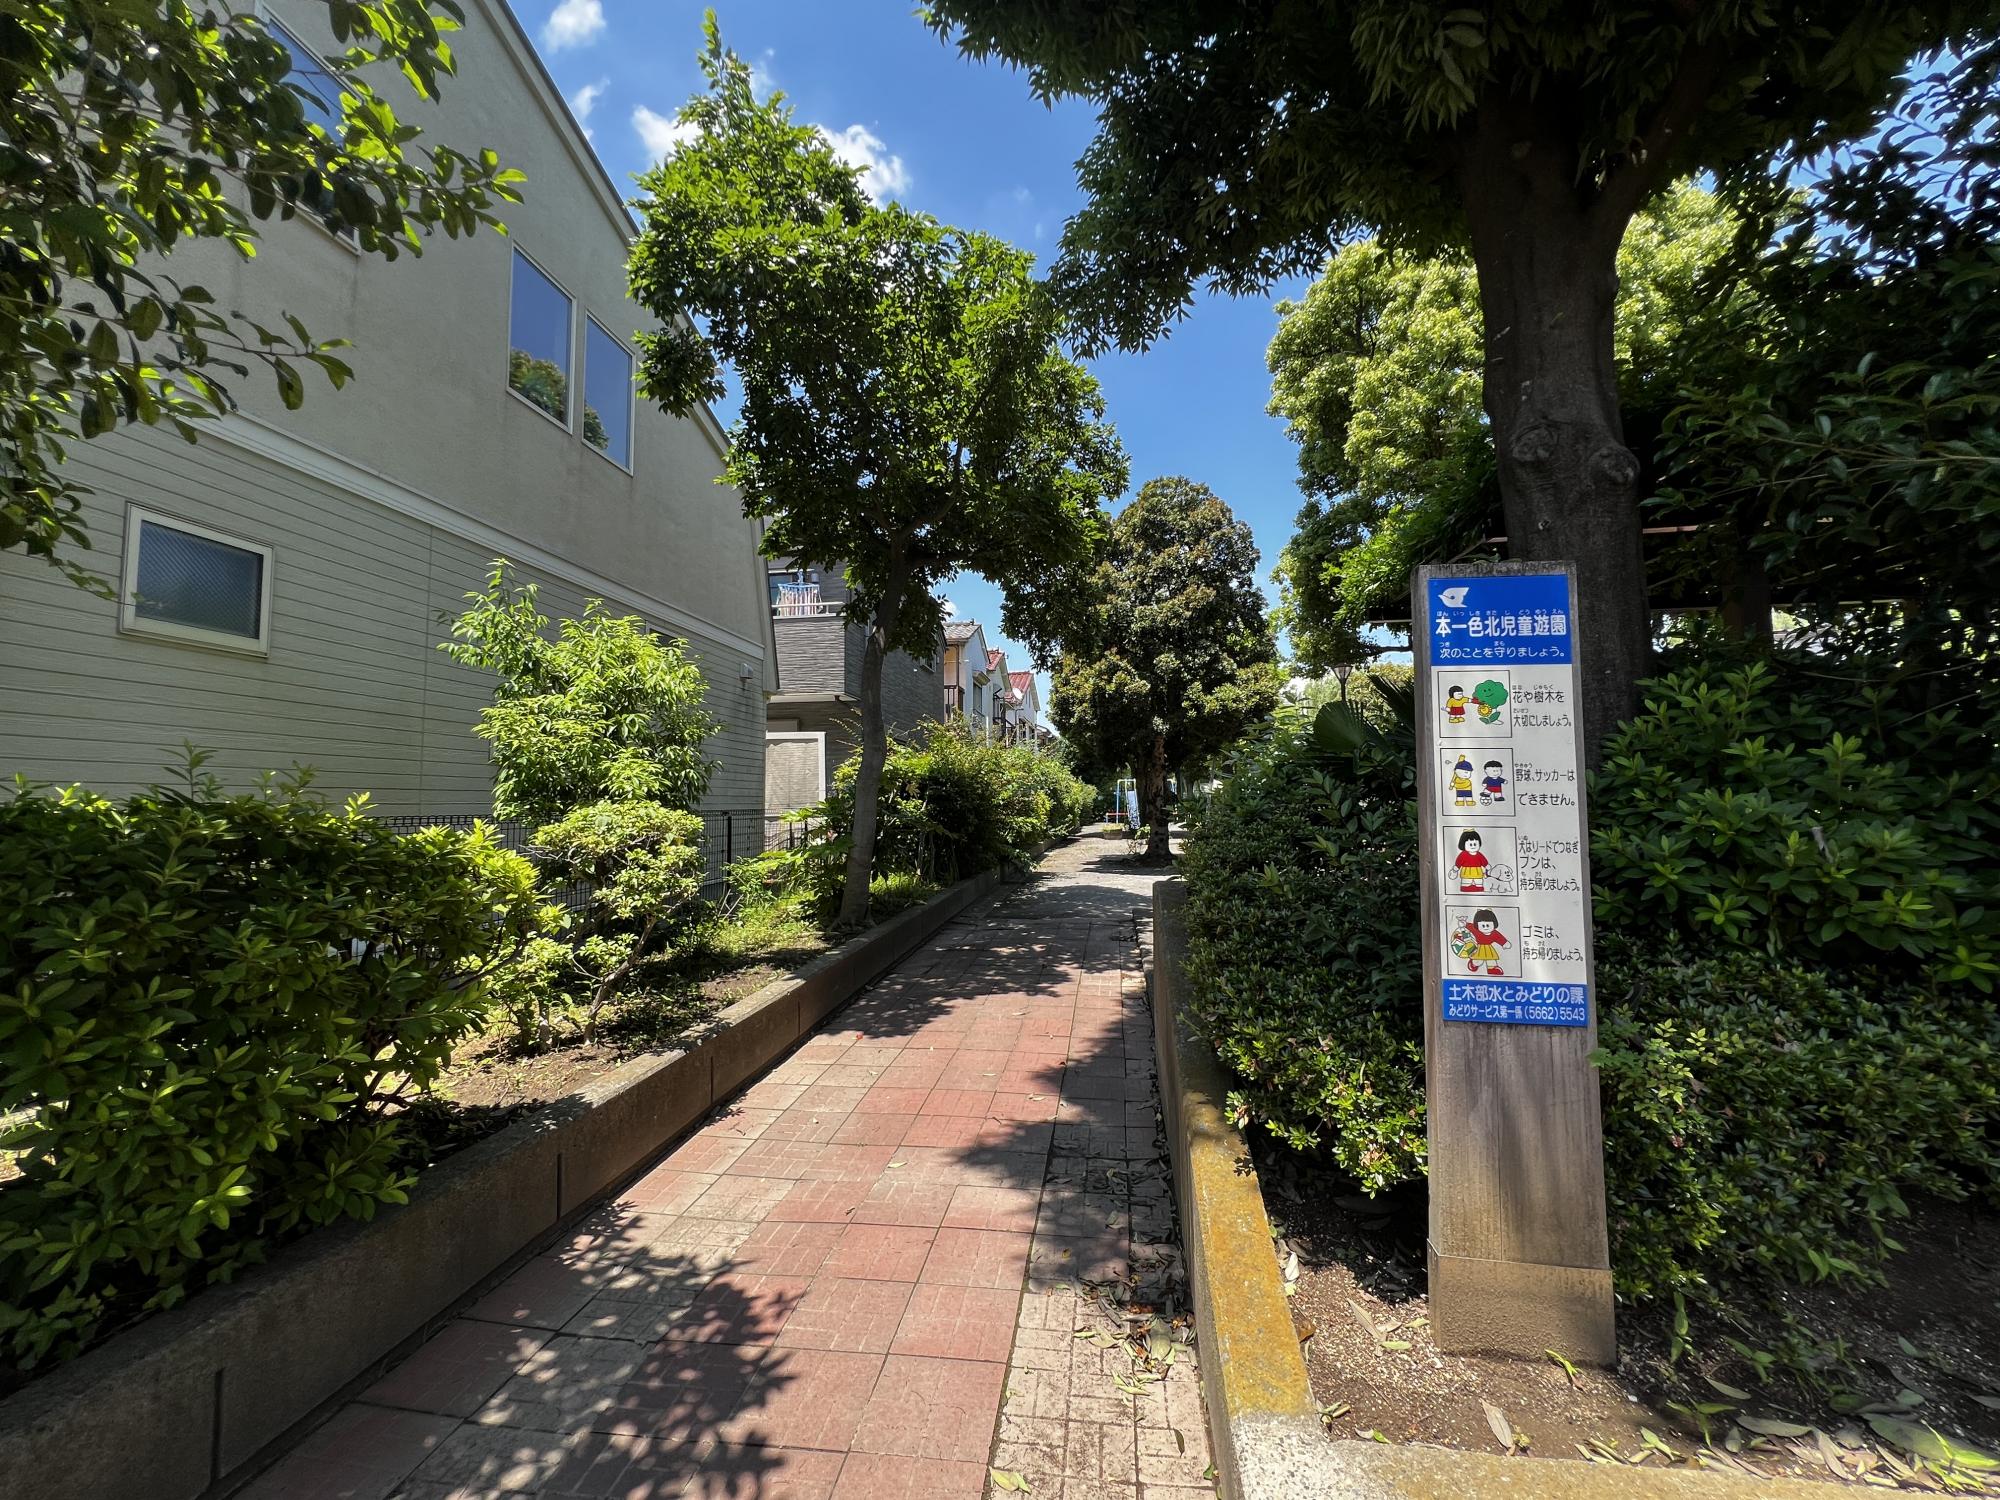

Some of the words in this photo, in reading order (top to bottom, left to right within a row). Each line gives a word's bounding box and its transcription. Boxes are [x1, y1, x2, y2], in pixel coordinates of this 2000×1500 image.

[1435, 615, 1567, 638] 本一色北児童遊園
[1439, 647, 1565, 658] 次のことを守りましょう。
[1512, 690, 1565, 703] 花や樹木を
[1513, 714, 1572, 727] 大切にしましょう。
[1515, 768, 1575, 782] 野球、サッカーは
[1517, 792, 1575, 806] できません。
[1519, 840, 1579, 854] 犬はリードでつなぎ
[1519, 856, 1557, 869] フンは、
[1520, 878, 1581, 891] 持ち帰りましょう。
[1522, 925, 1560, 939] ゴミは、
[1522, 947, 1584, 961] 持ち帰りましょう。
[1448, 983, 1585, 1005] 土木部水とみどりの課
